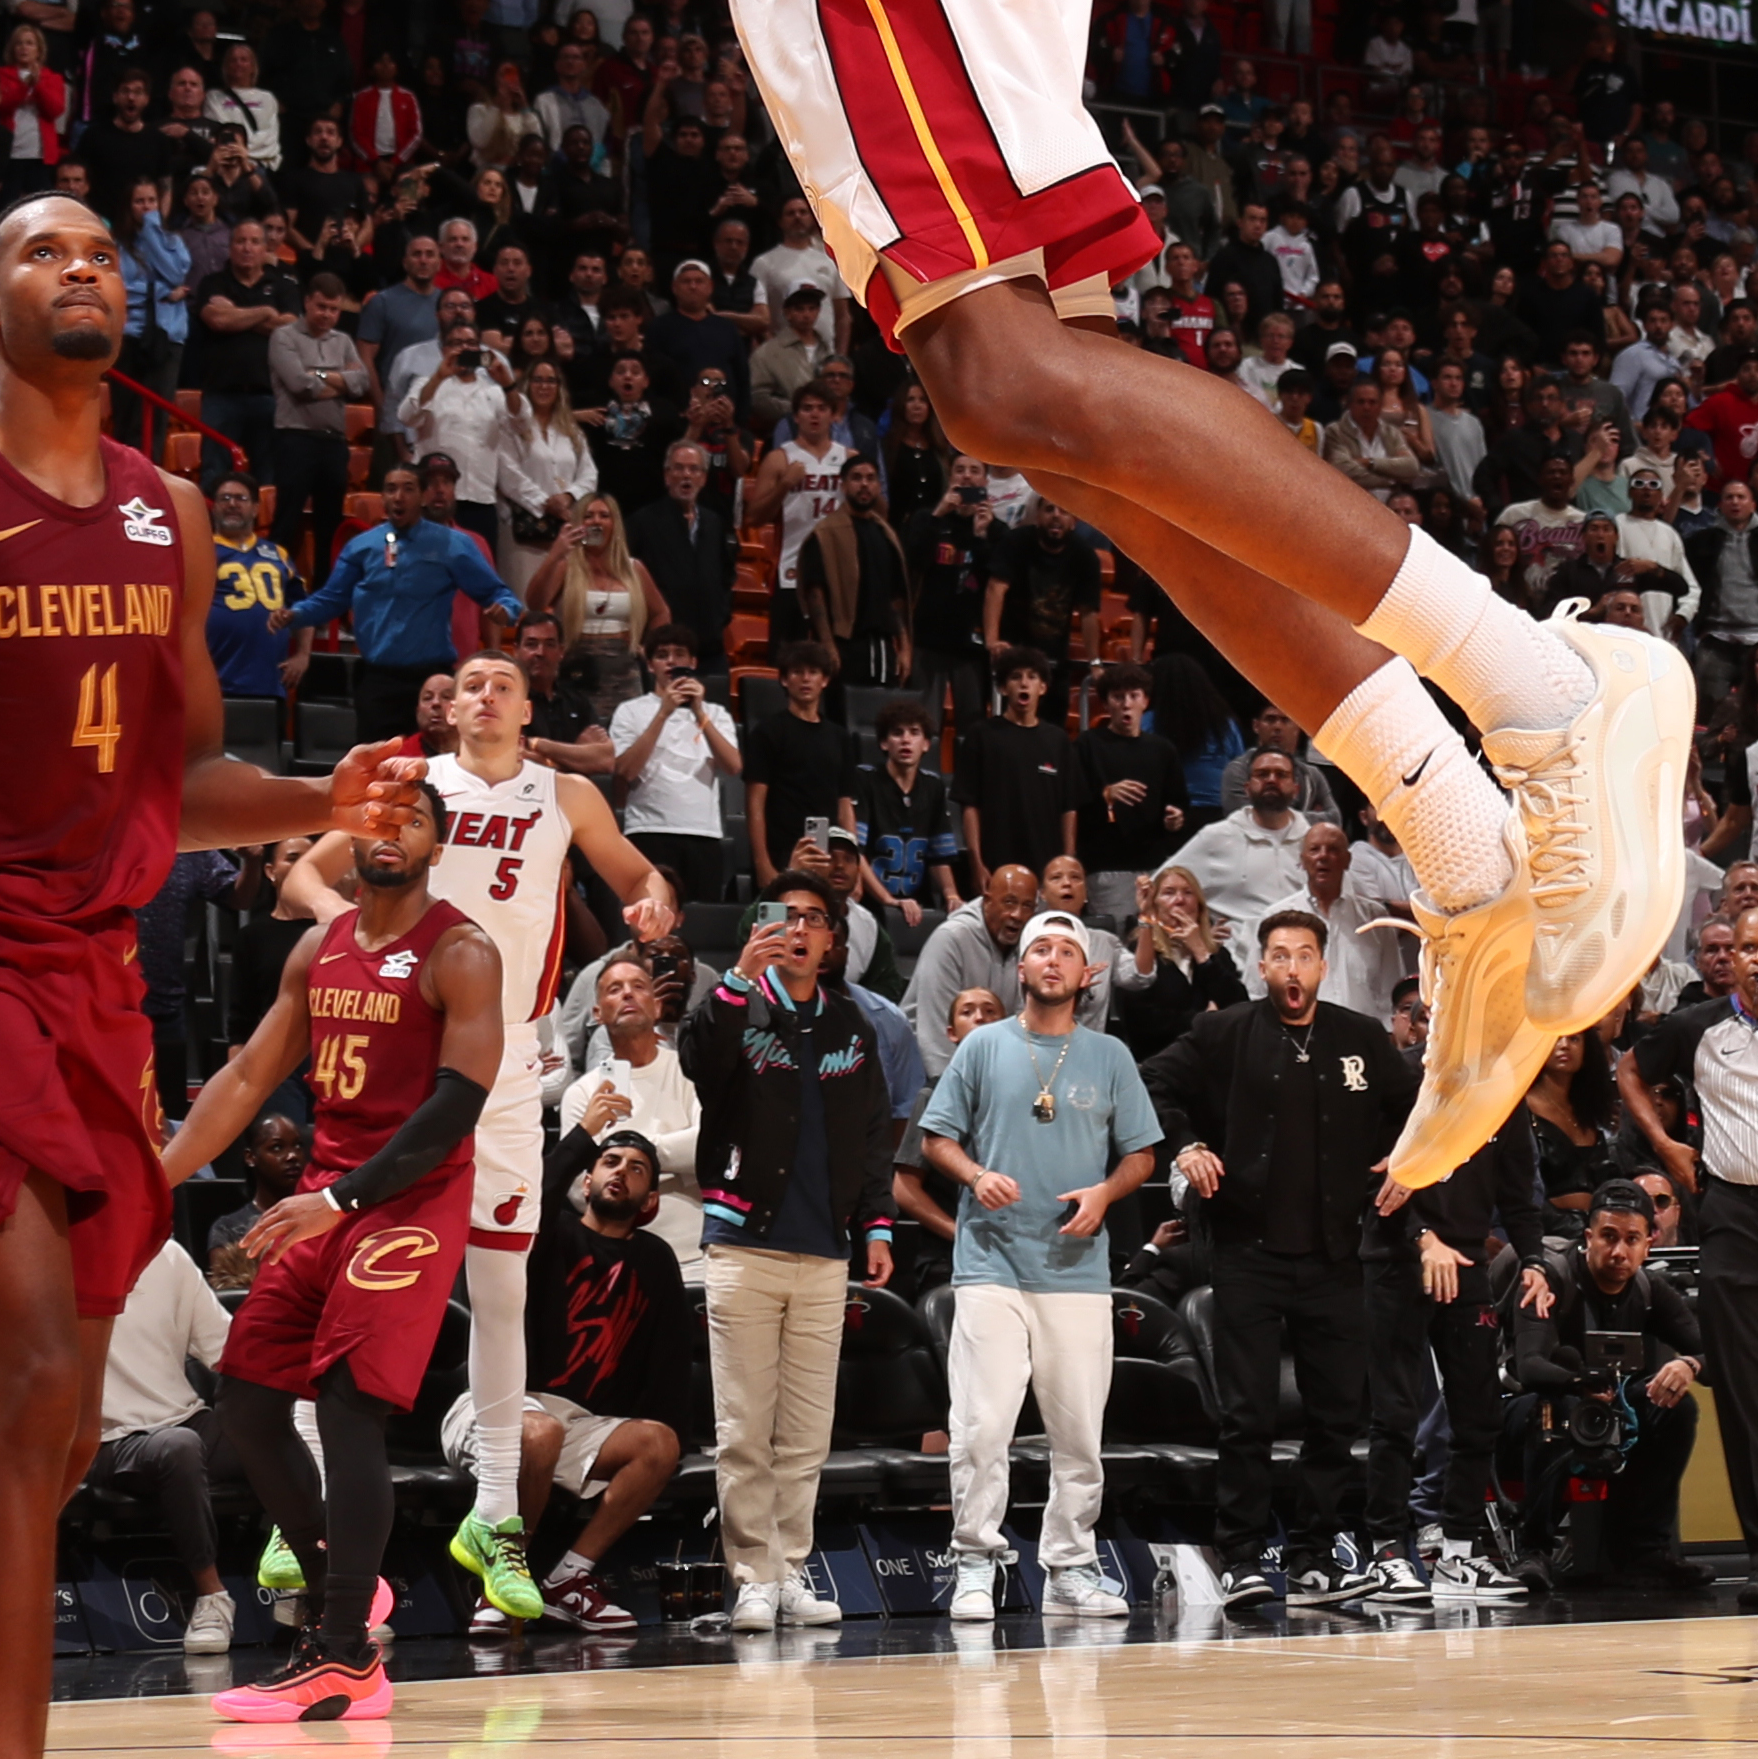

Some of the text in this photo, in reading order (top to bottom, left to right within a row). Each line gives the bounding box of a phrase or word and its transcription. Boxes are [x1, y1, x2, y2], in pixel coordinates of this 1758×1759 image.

[125, 523, 170, 542] CLIFFS
[216, 562, 285, 612] 30
[70, 660, 123, 774] 4
[488, 856, 525, 902] 5
[307, 986, 403, 1026] CLEVELAND
[313, 1034, 371, 1102] 45
[875, 1557, 914, 1577] ONE
